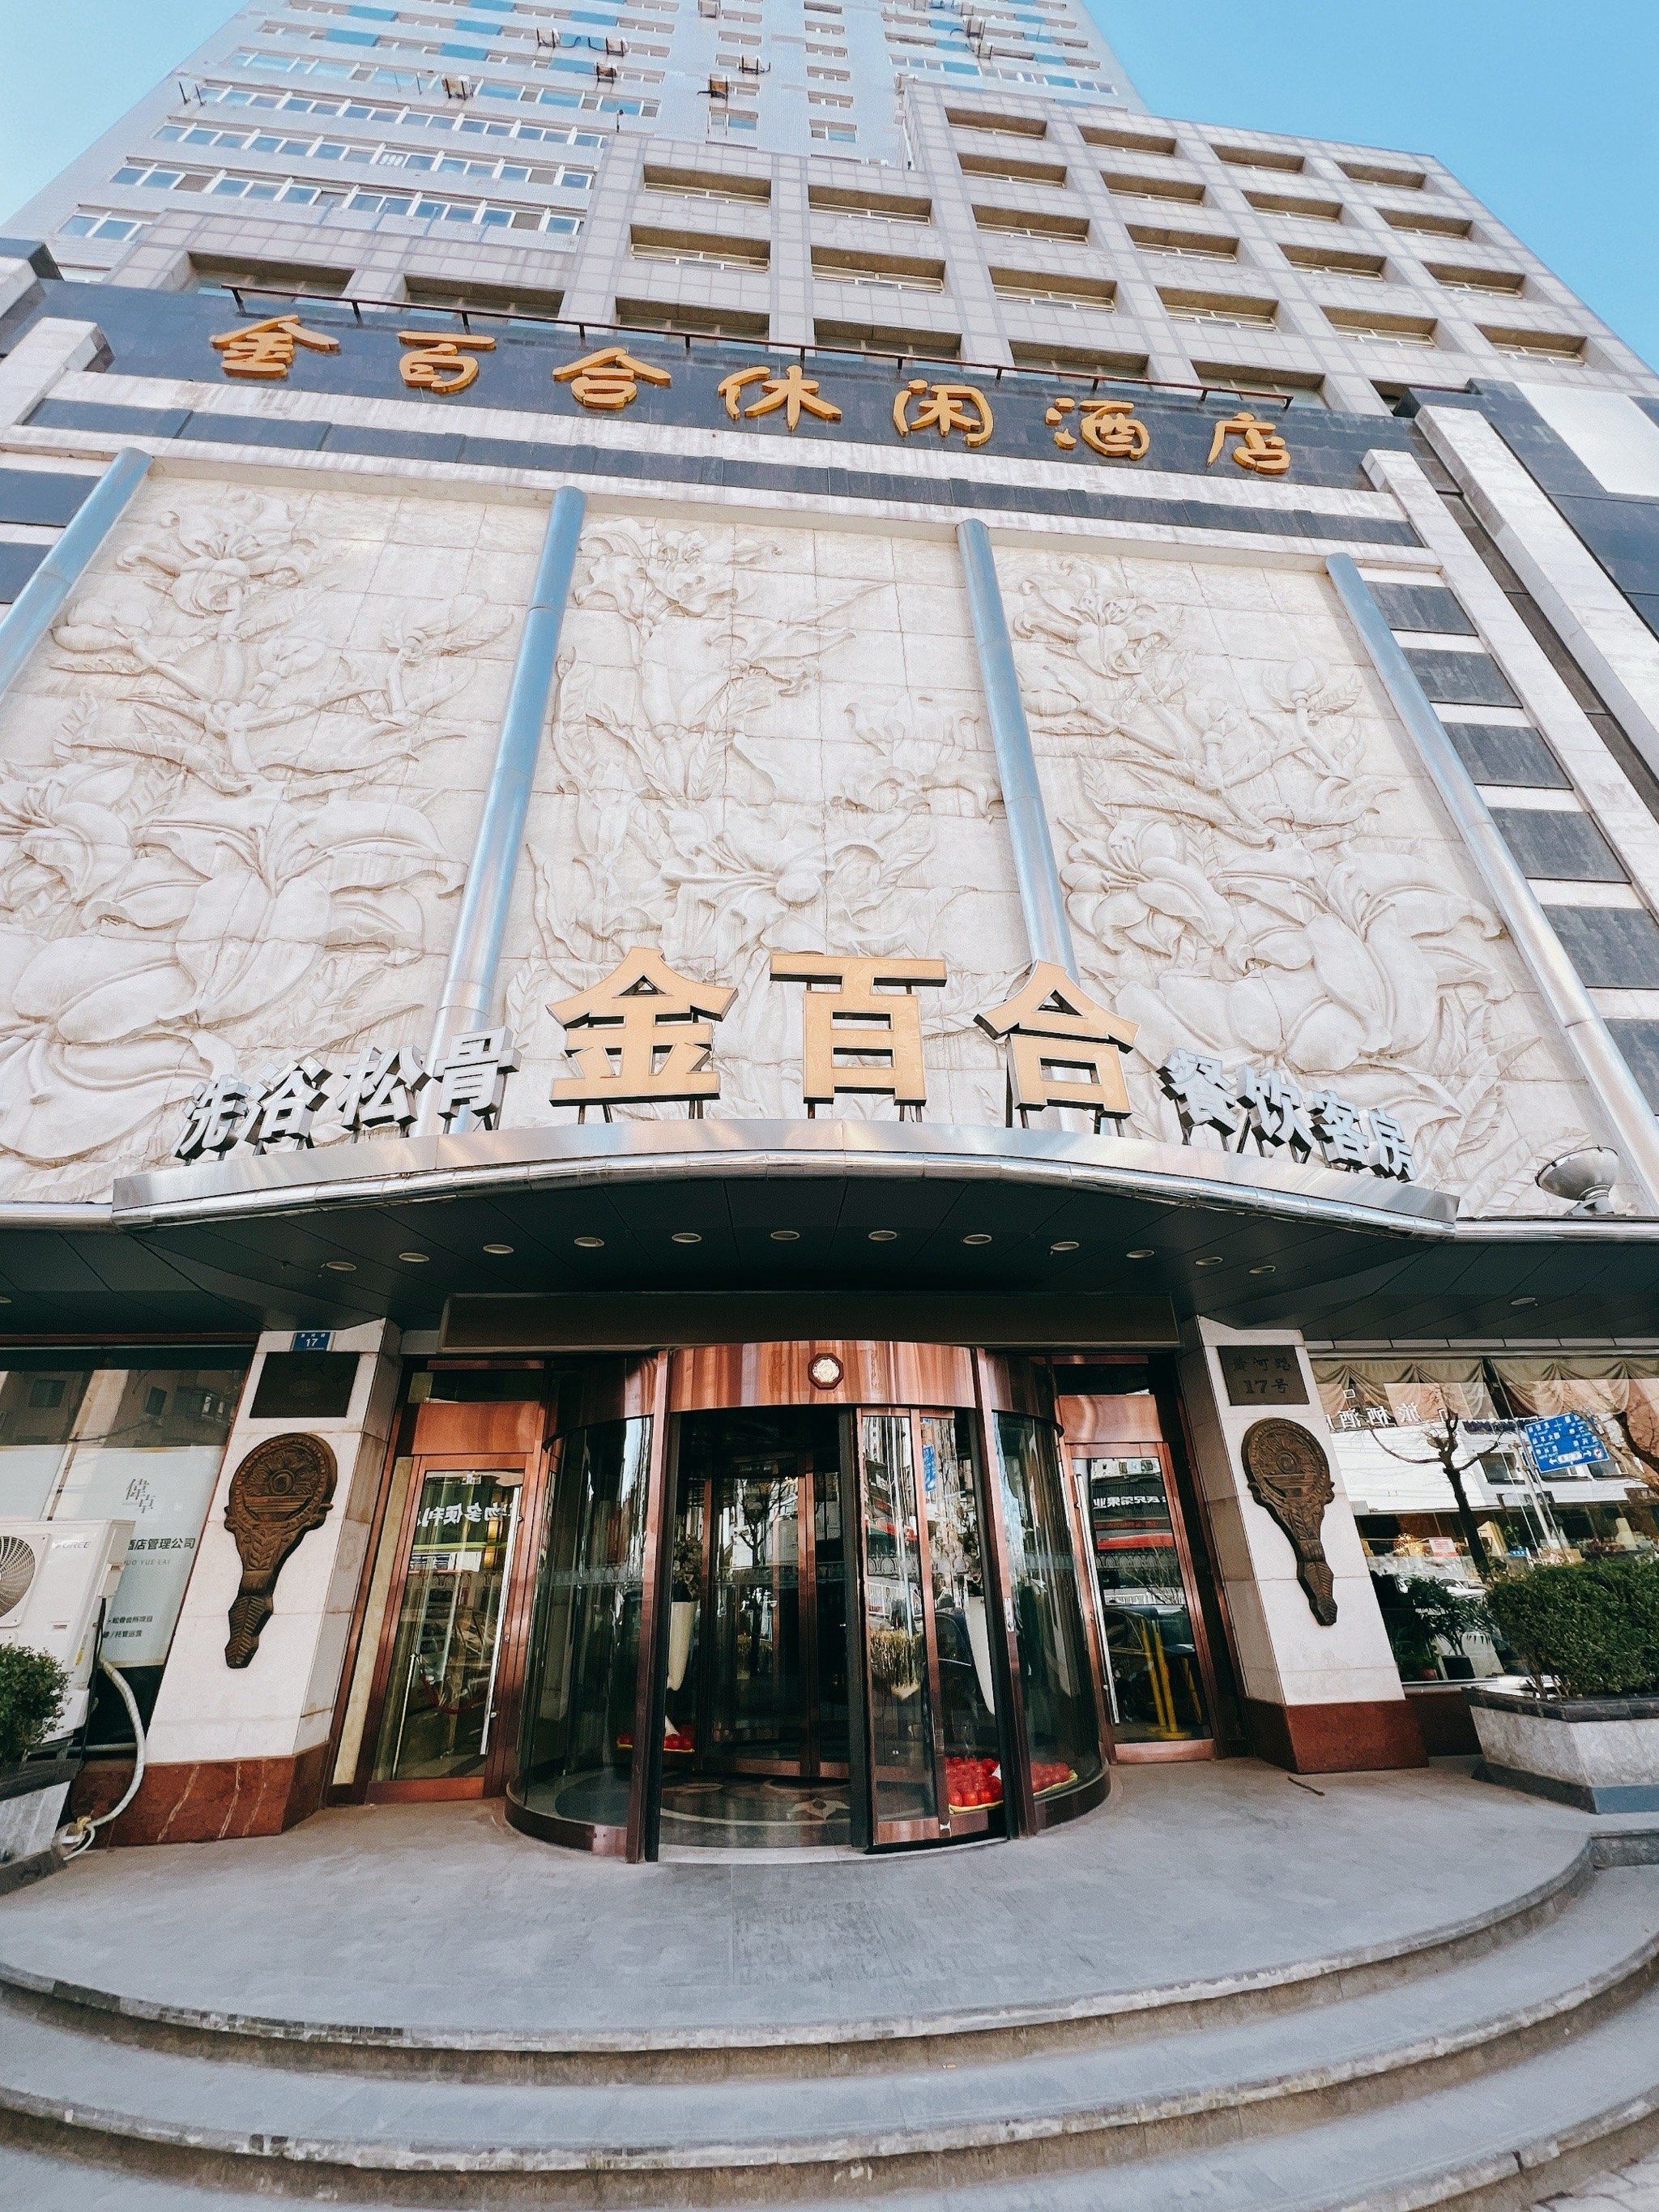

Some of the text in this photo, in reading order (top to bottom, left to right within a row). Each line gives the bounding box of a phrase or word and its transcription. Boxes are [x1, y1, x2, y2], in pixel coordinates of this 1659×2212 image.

[209, 314, 1292, 475] 金百合休闲酒店
[173, 946, 1418, 1183] 洗浴松骨 金百合 餐饮客房
[306, 1338, 318, 1347] 17
[1243, 1378, 1289, 1394] 17号
